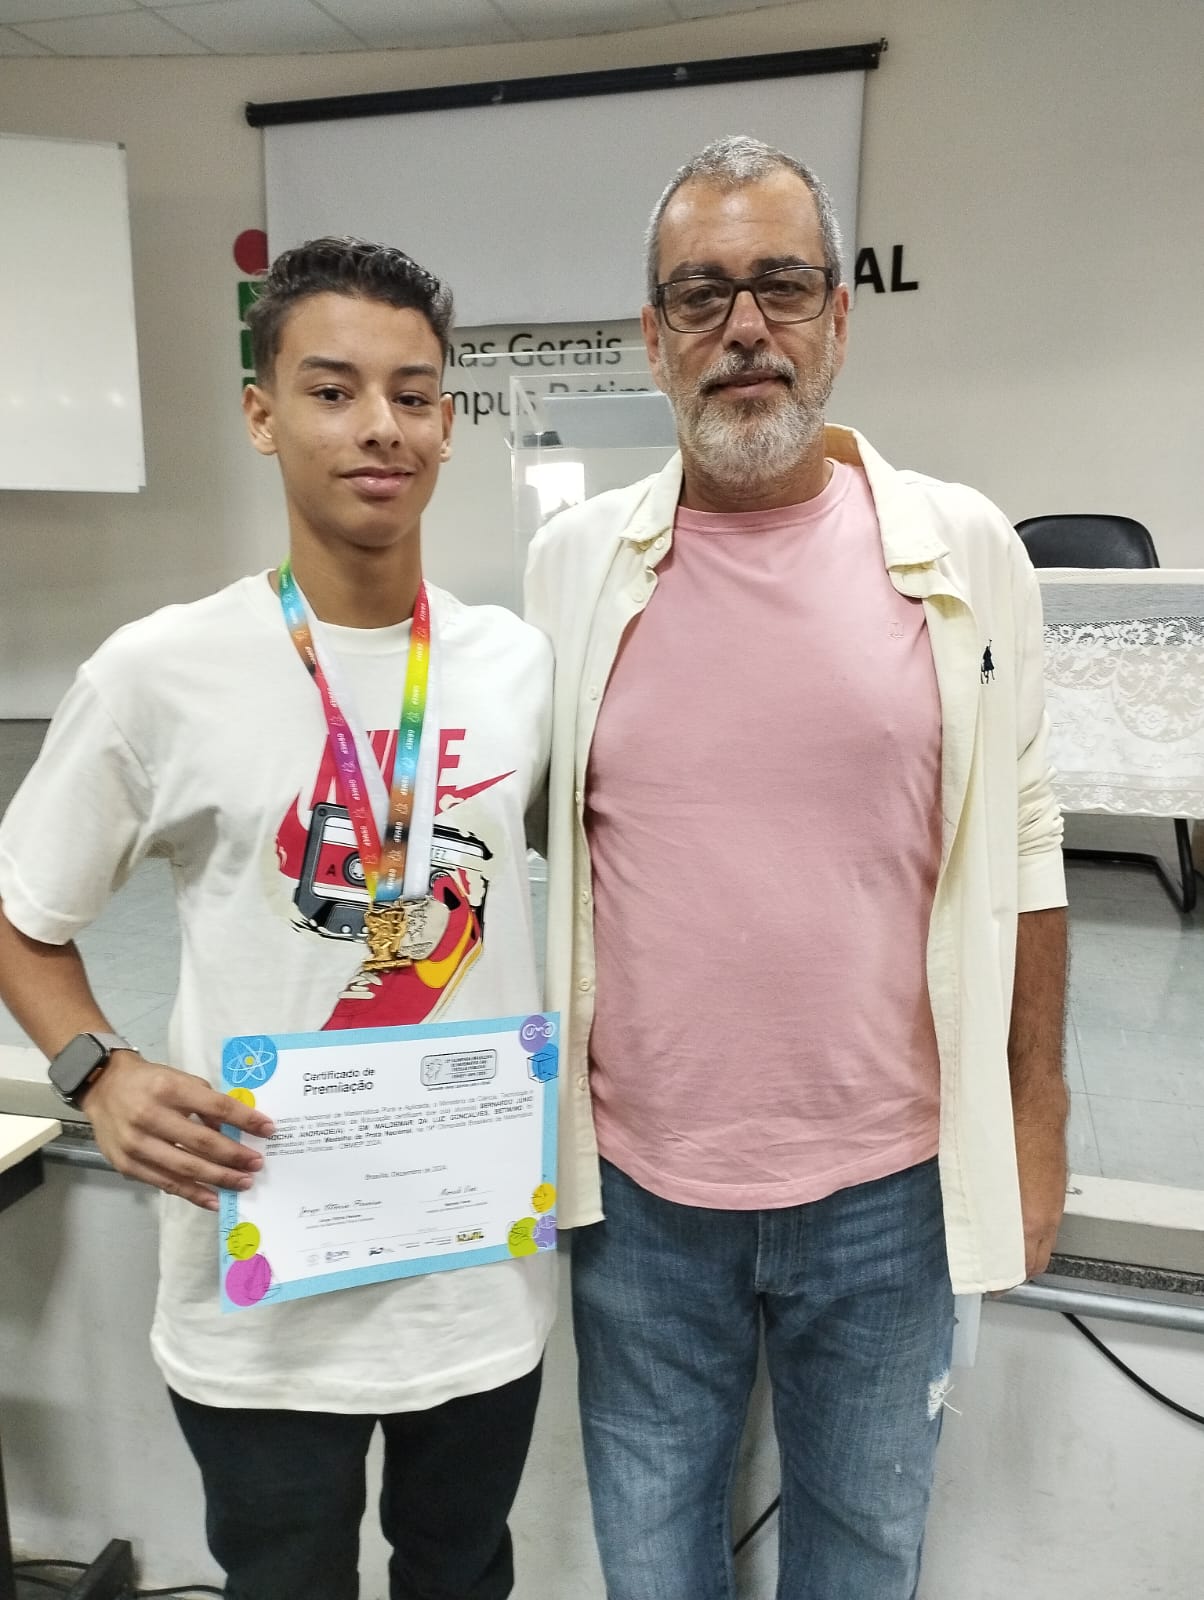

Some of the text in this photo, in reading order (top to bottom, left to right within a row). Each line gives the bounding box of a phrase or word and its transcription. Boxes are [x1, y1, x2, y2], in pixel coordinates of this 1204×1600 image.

[508, 330, 622, 367] Gerais
[326, 864, 337, 877] A
[303, 1067, 375, 1081] Certificado de
[303, 1080, 374, 1096] Premiação
